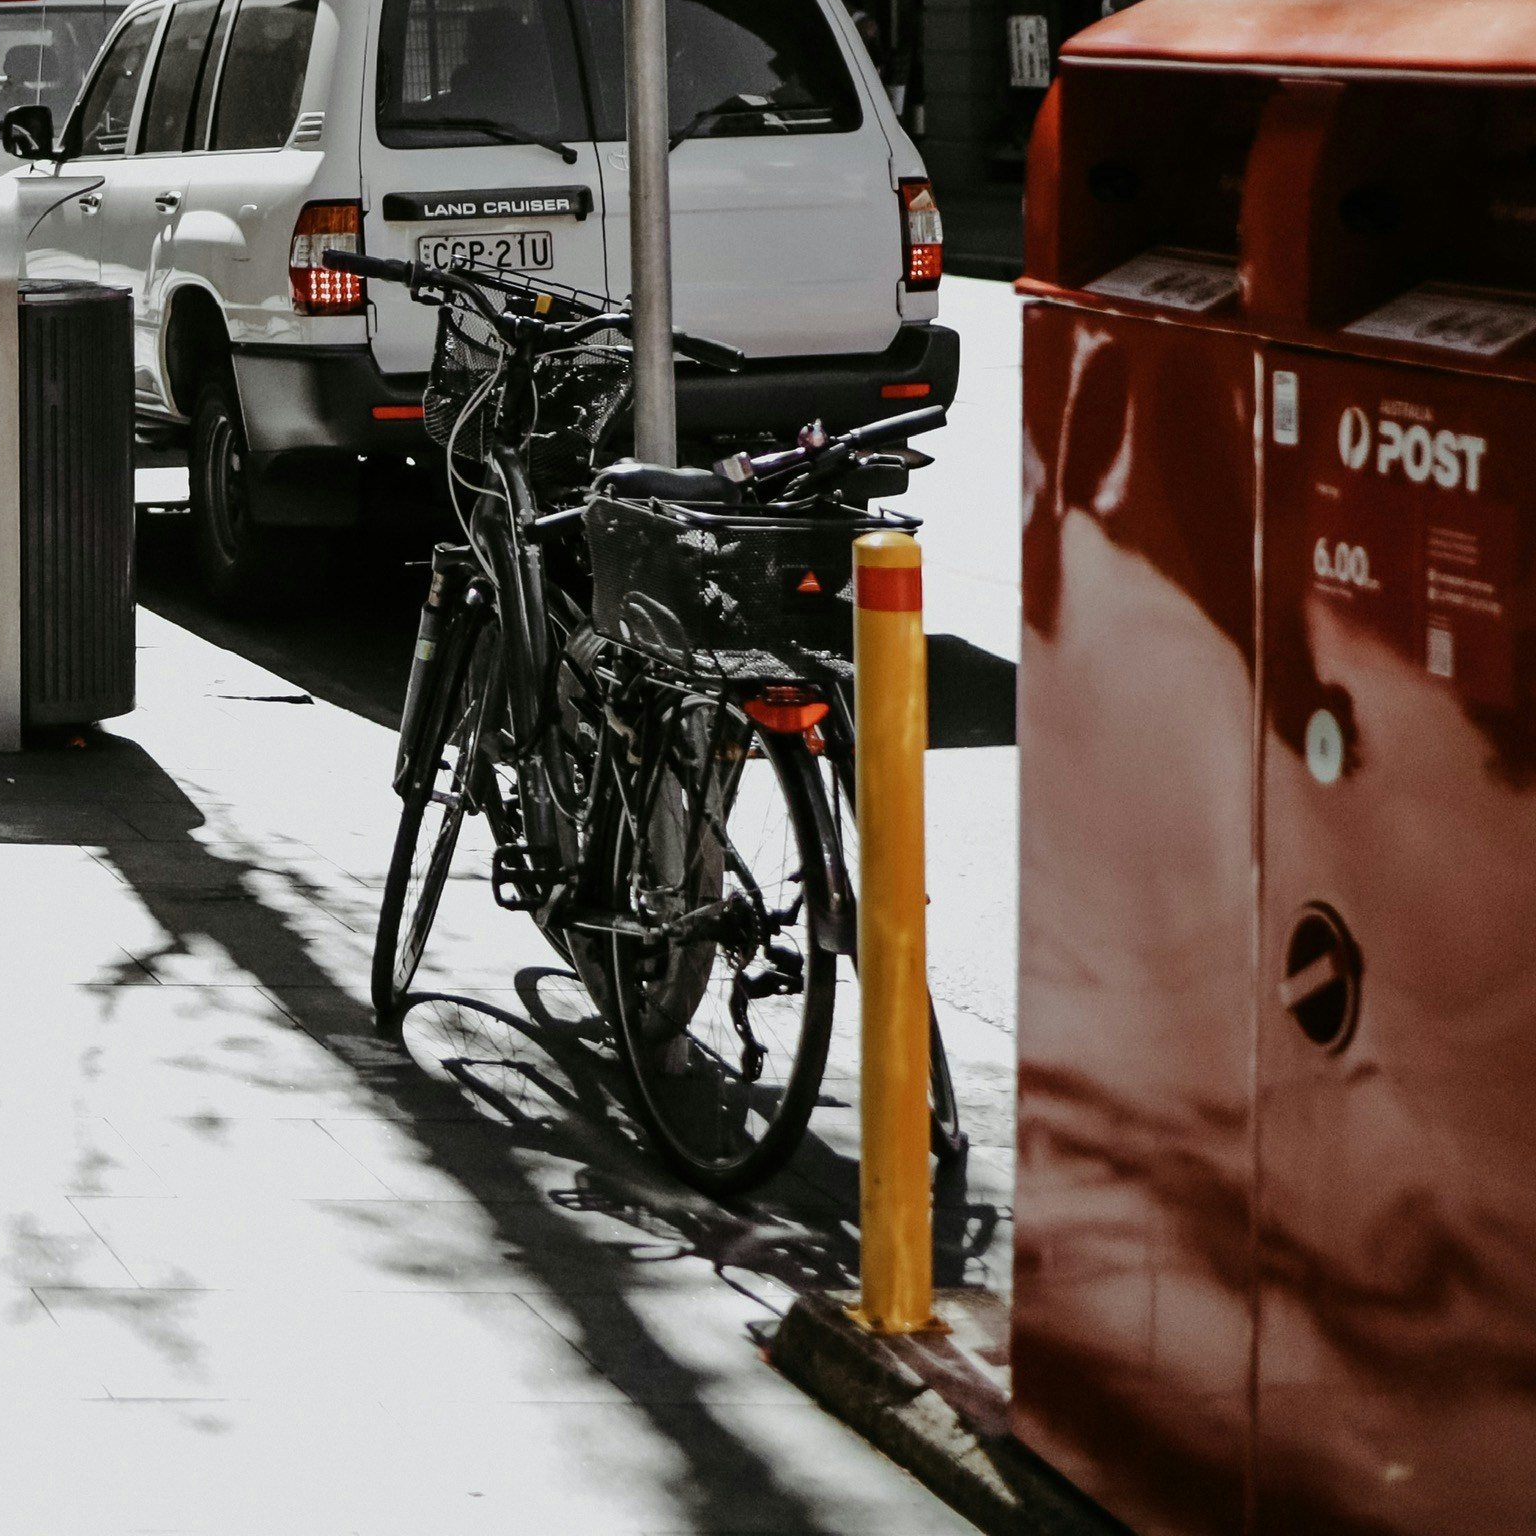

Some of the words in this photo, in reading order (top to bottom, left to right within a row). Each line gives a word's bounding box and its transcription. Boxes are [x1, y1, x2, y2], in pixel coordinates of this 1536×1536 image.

[424, 202, 476, 217] LAND
[483, 199, 570, 214] CRUISER
[1377, 419, 1488, 492] POST
